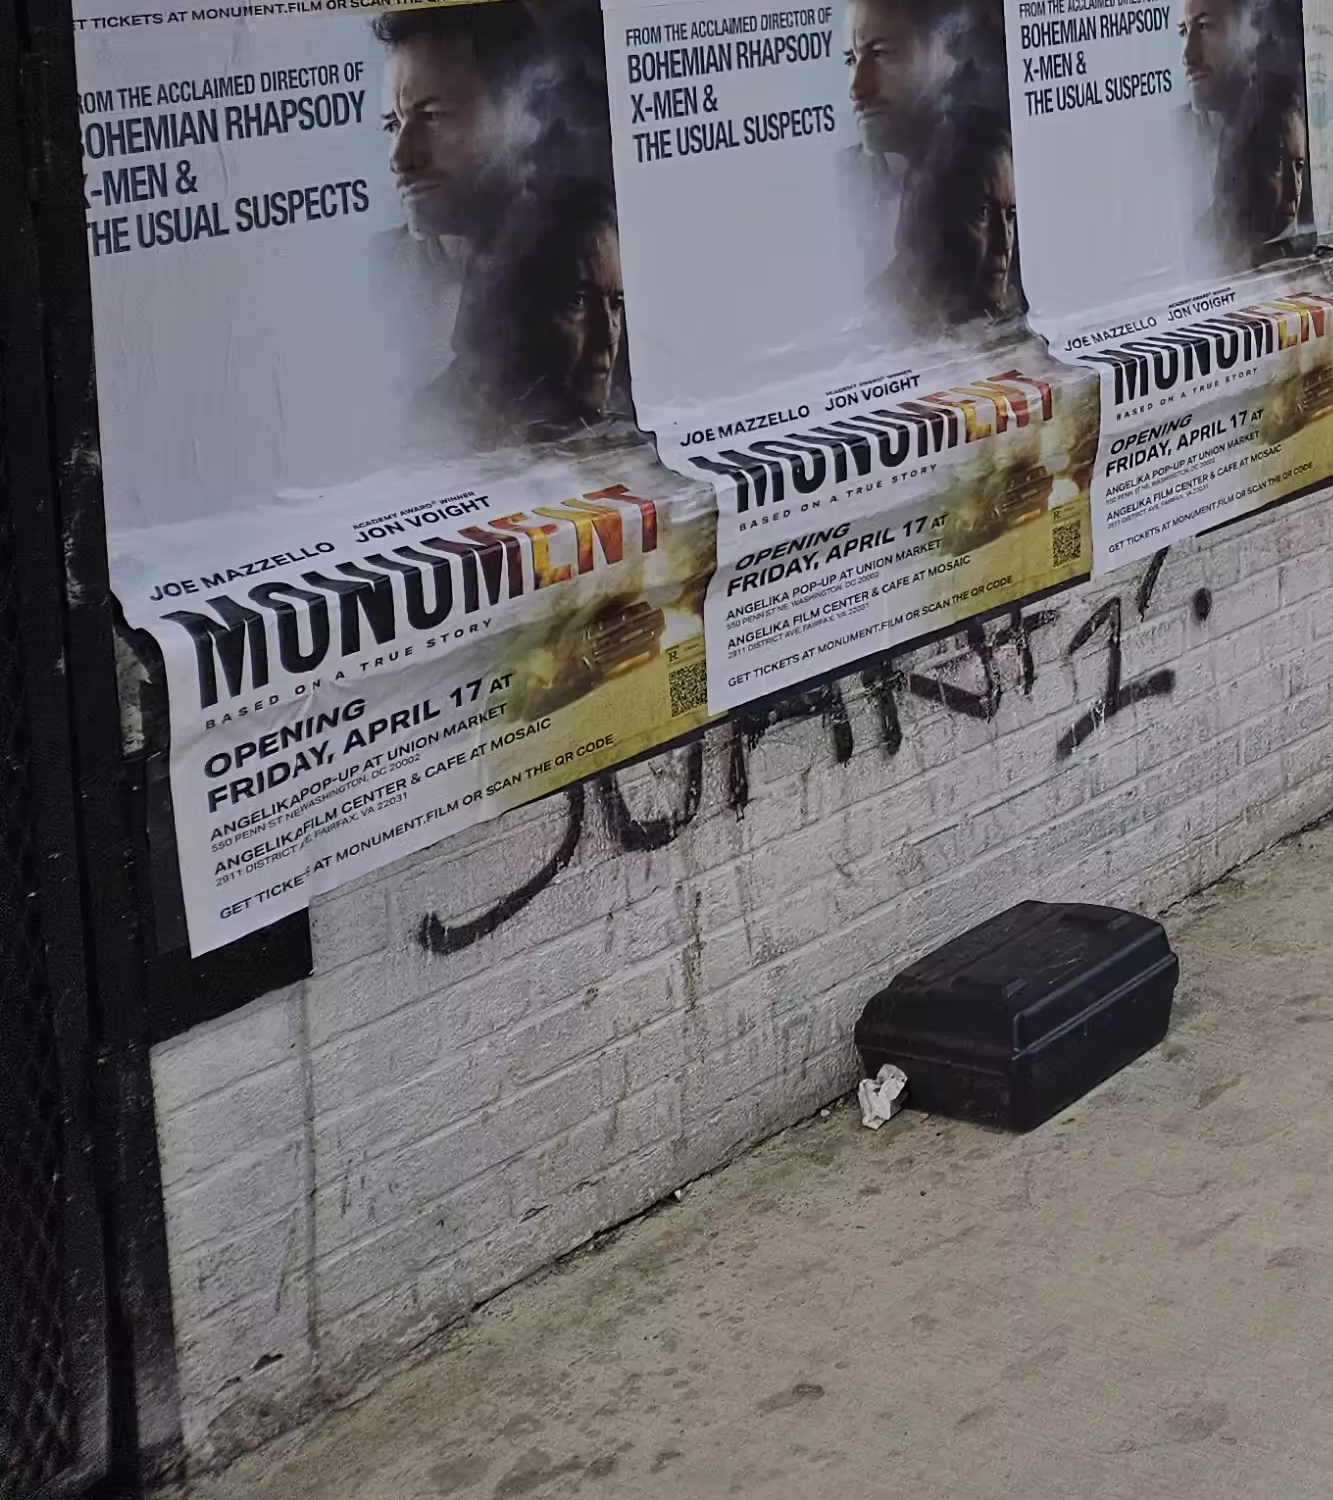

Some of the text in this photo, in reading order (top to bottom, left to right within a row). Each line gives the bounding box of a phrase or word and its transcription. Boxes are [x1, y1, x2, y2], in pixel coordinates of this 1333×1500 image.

[1021, 6, 1170, 50] BOHEMIAN RHAPSODY
[116, 85, 152, 109] THE
[157, 74, 255, 105] ACCLAIMED
[260, 64, 338, 93] DIRECTOR
[344, 61, 364, 82] OF
[628, 31, 832, 84] BOHEMIAN RHAPSODY
[1023, 51, 1087, 83] X-MEN &
[631, 84, 718, 124] X-MEN &
[1025, 69, 1172, 116] THE USUAL SUSPECTS
[85, 90, 365, 160] OHEMIAN RHAPSODY
[633, 105, 835, 162] THE USUAL SUSPECTS
[90, 160, 198, 207] -MEN &
[87, 179, 369, 257] HE USUAL SUSPECTS
[824, 375, 921, 412] JON VOIGHT
[680, 405, 810, 448] JOE MAZZELLO
[1110, 414, 1193, 455] OPENING
[354, 496, 489, 544] JON VOIGHT
[439, 491, 476, 505] WINNER
[149, 541, 335, 602] JOE MAZZELLO
[727, 513, 949, 597] FRIDAY, APRIL 17 AT
[734, 522, 851, 571] OPENING
[160, 484, 657, 708] MONUMENT
[205, 618, 492, 730] BASED ON A TRUE STORY
[204, 698, 366, 779] OPENING
[208, 673, 514, 814] FRIDAY, APRIL 17 AT
[211, 703, 508, 841] ANGELIKA POP-UP AT UNION MARKET
[215, 718, 552, 876] ANGELIKA FILM CENTER & CAFE AT MOSAIC
[234, 825, 266, 843] PENN
[269, 816, 283, 829] ST
[372, 768, 388, 780] DC
[389, 753, 421, 773] 20002
[220, 897, 252, 920] GET
[313, 856, 333, 874] AT
[463, 790, 483, 806] OR
[486, 772, 522, 797] SCAN
[525, 760, 552, 780] THE
[555, 751, 573, 767] QR
[577, 734, 614, 757] CODE
